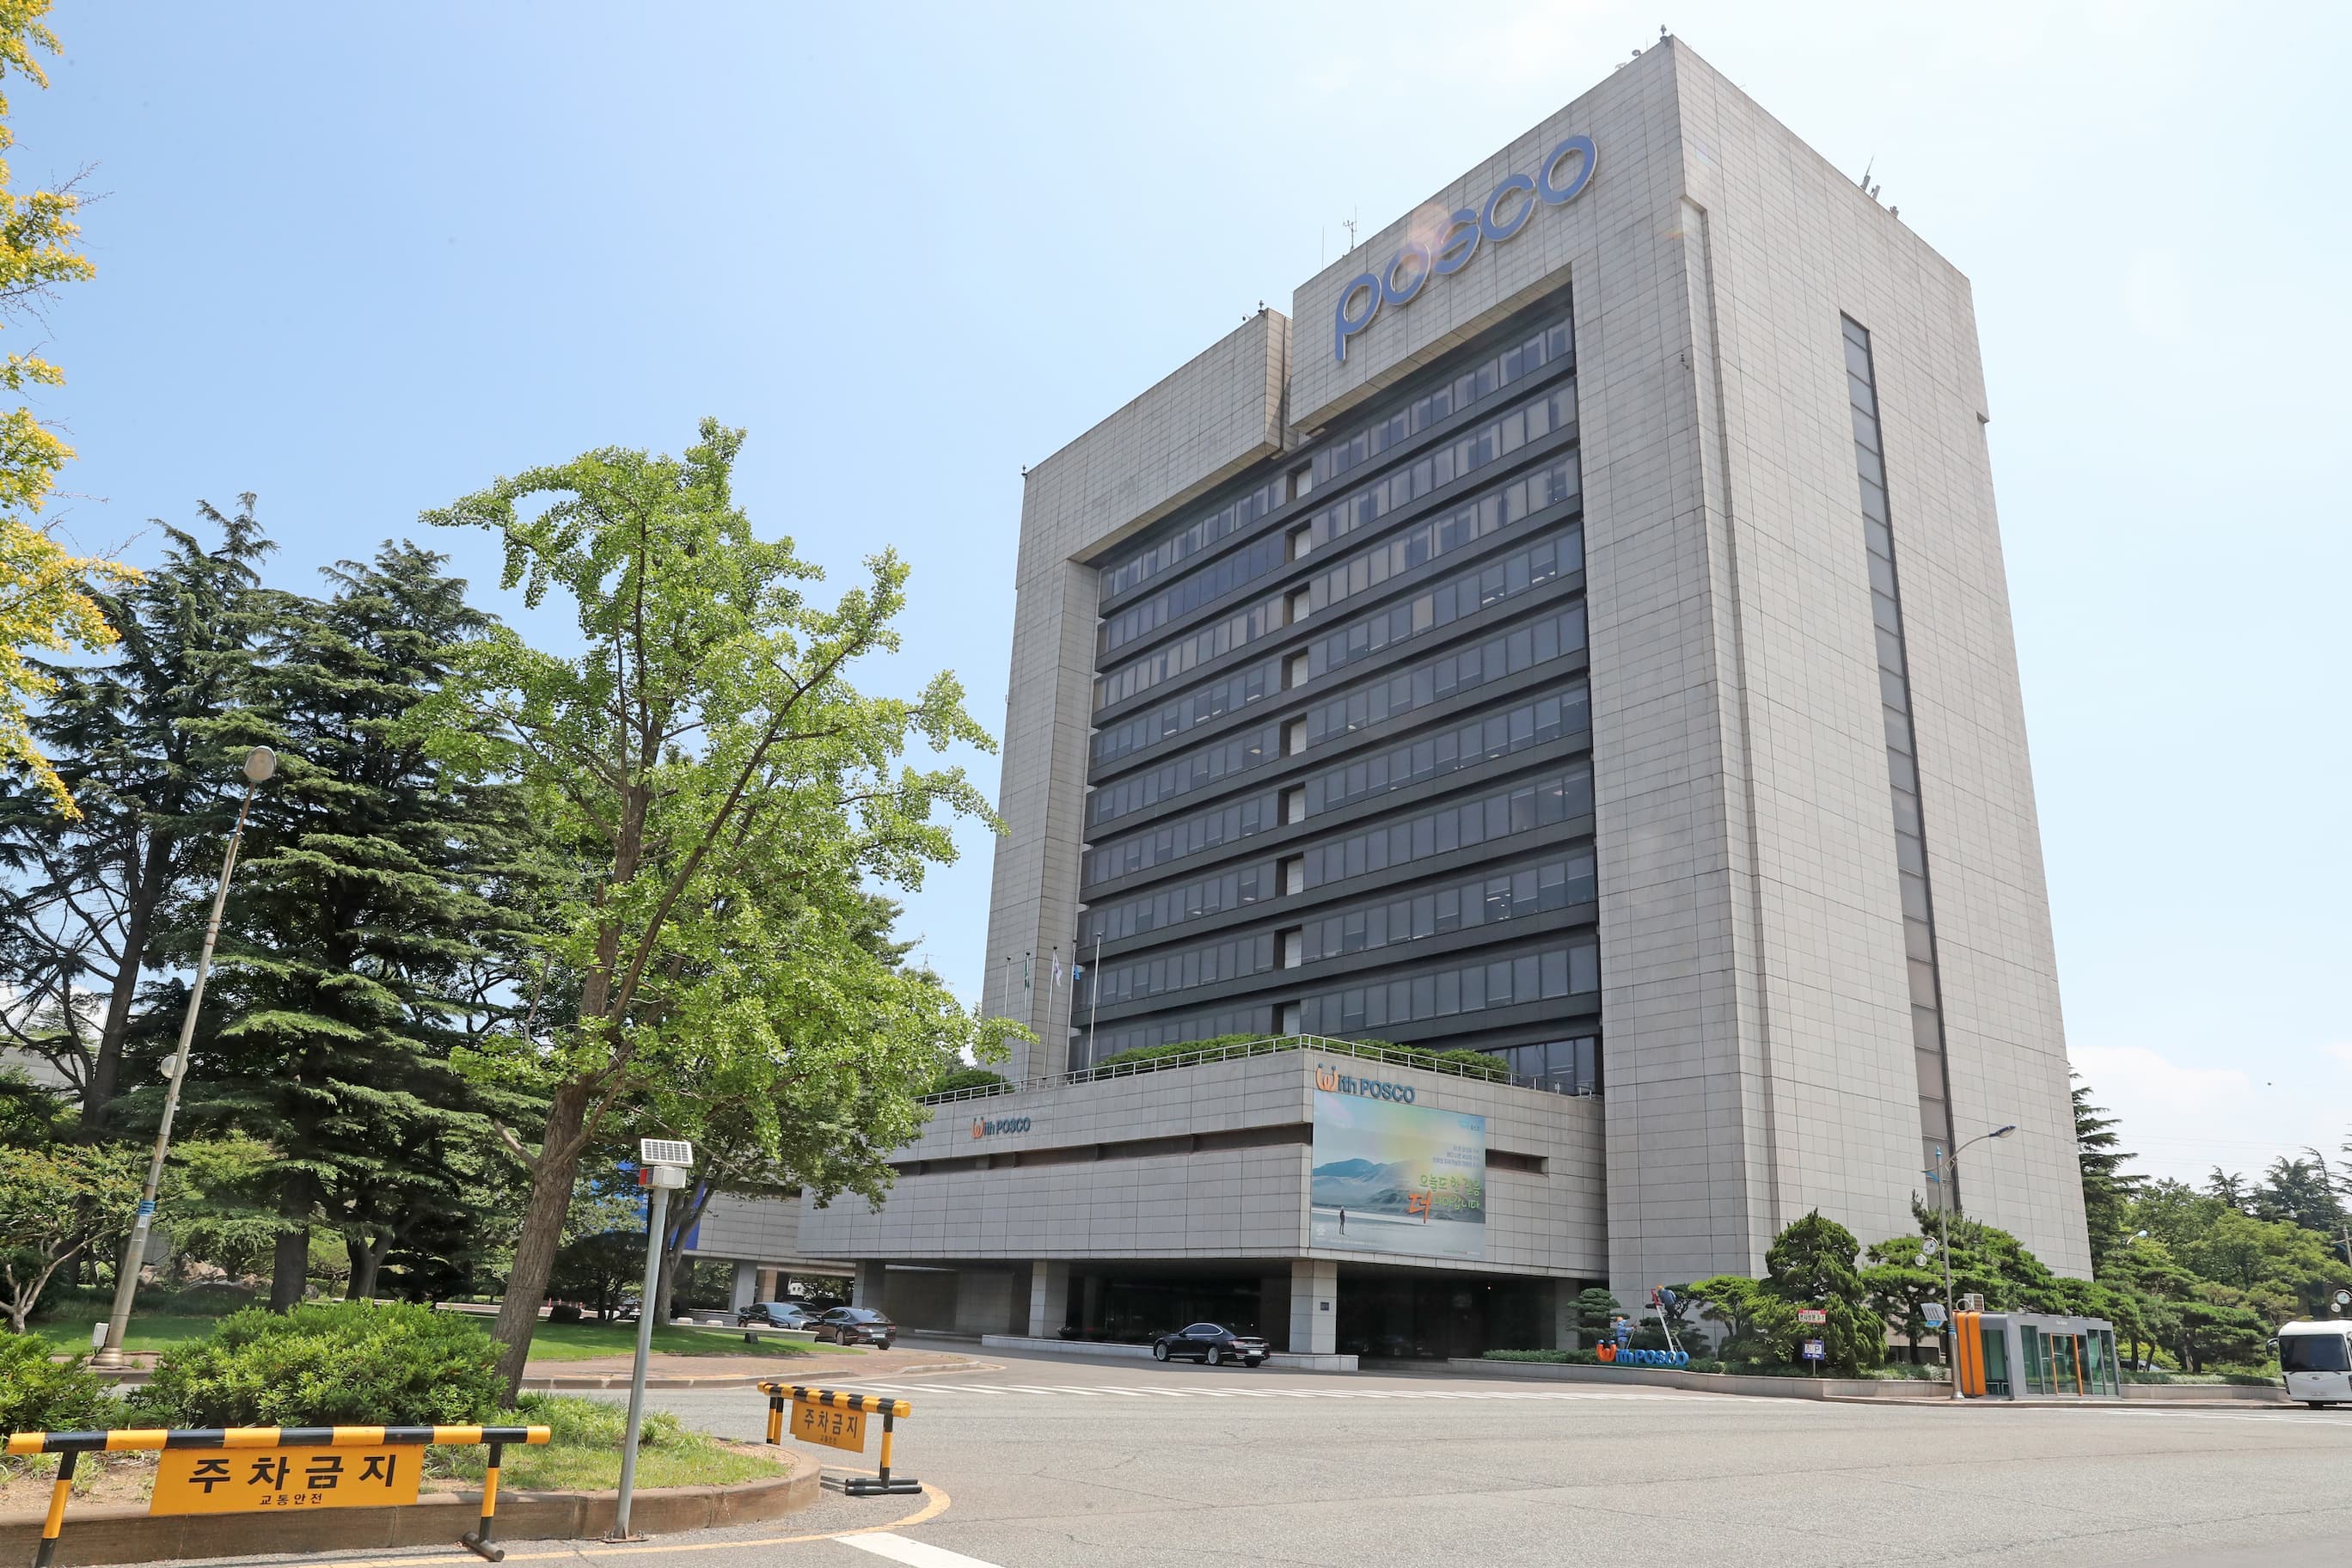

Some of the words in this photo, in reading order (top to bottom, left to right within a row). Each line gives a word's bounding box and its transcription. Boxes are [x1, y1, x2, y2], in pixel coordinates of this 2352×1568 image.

[1334, 134, 1598, 362] posco
[1316, 1063, 1357, 1094] With
[1360, 1077, 1416, 1104] POSCO
[971, 1116, 995, 1139] With
[996, 1117, 1031, 1135] POSCO
[1404, 1191, 1432, 1224] 더
[1634, 1349, 1690, 1366] POSCO
[804, 1408, 858, 1439] 주차금지
[188, 1454, 397, 1493] 주차금지
[259, 1492, 323, 1506] 교통안전
